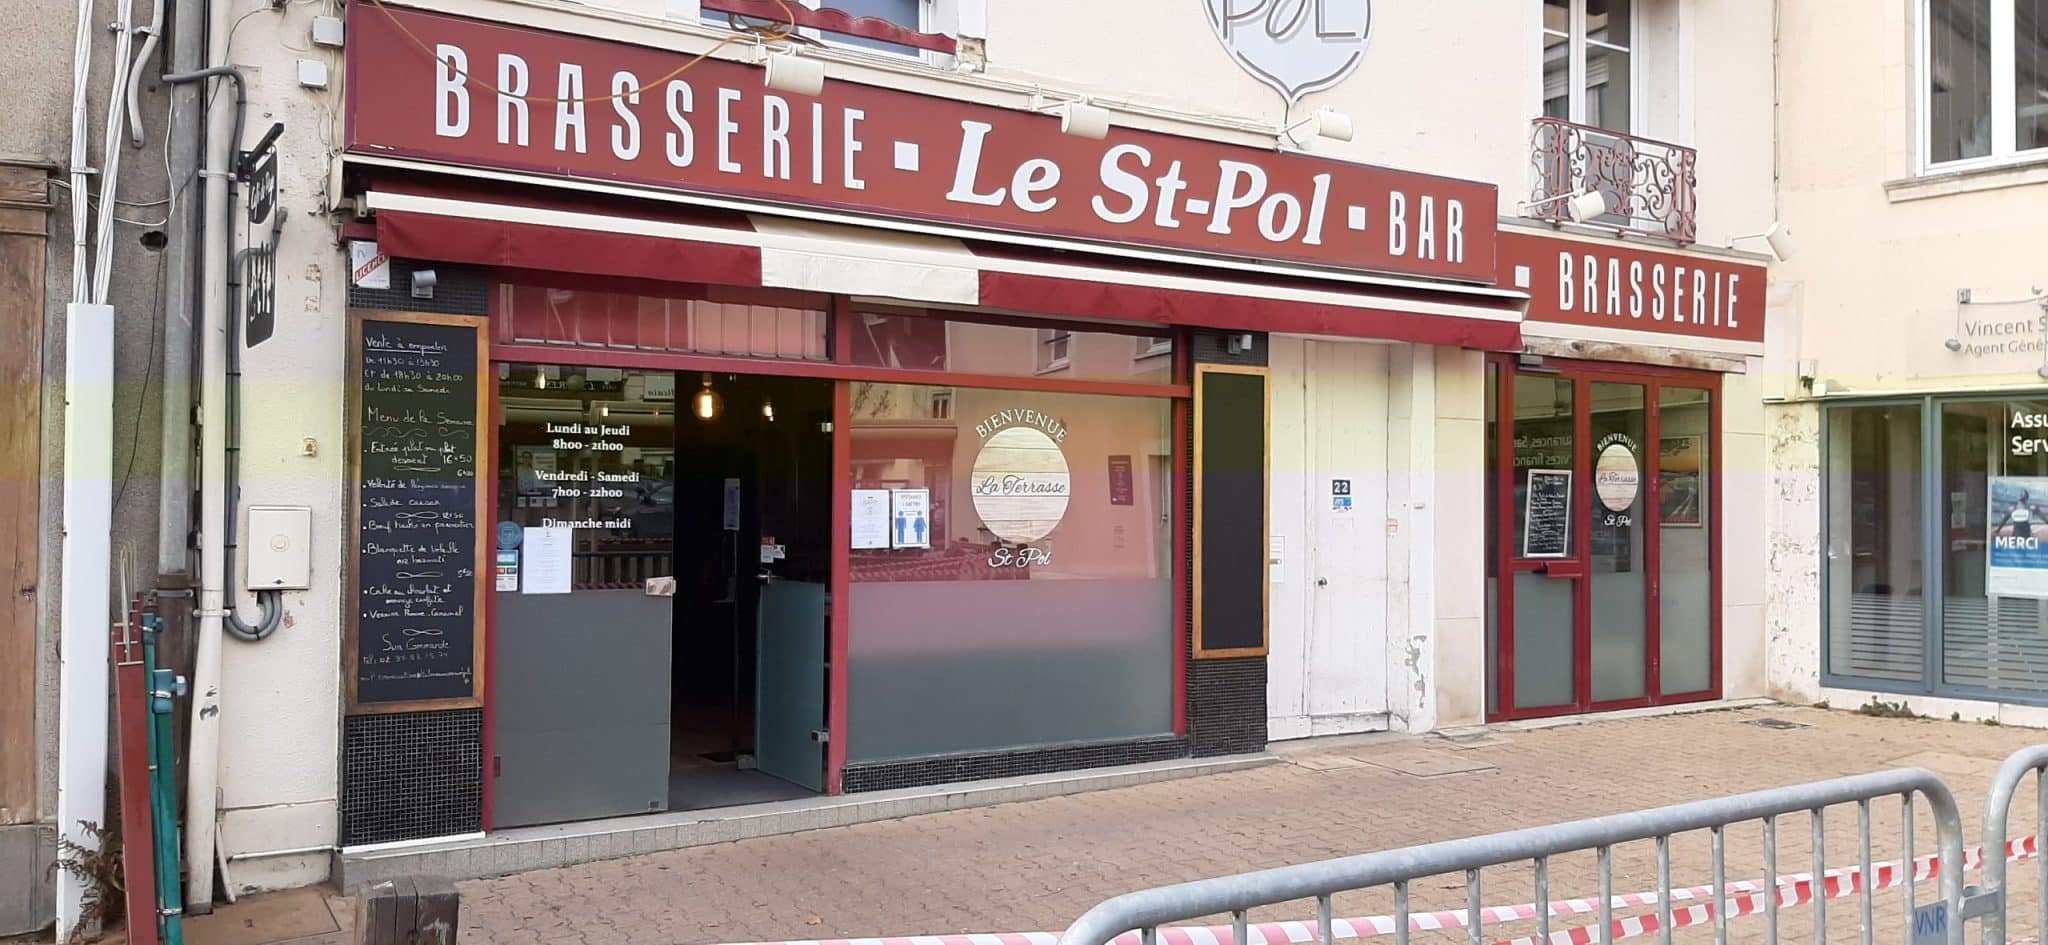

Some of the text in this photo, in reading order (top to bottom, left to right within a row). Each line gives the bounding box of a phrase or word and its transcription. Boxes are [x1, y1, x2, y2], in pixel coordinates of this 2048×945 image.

[435, 43, 1464, 264] BRASSERIE Le St-Pol BAR
[1559, 252, 1740, 328] BRASSERIE
[1965, 320, 2033, 337] Vincent
[366, 333, 392, 348] Vente
[1964, 342, 2004, 358] Agent
[368, 405, 399, 422] Menu
[403, 409, 416, 423] de
[547, 423, 630, 437] Lundi au Jeudi
[975, 408, 1068, 443] BIENVENUE
[1597, 433, 1637, 451] BIENVENUE
[535, 470, 588, 481] Vendredi
[597, 471, 640, 483] Samedi
[975, 474, 1066, 496] La Terrasse
[1334, 481, 1348, 493] 22
[542, 518, 631, 530] Dimanche midi
[1995, 536, 2039, 551] MERCI
[988, 548, 1052, 568] St Pol
[1914, 904, 1946, 936] VNR
